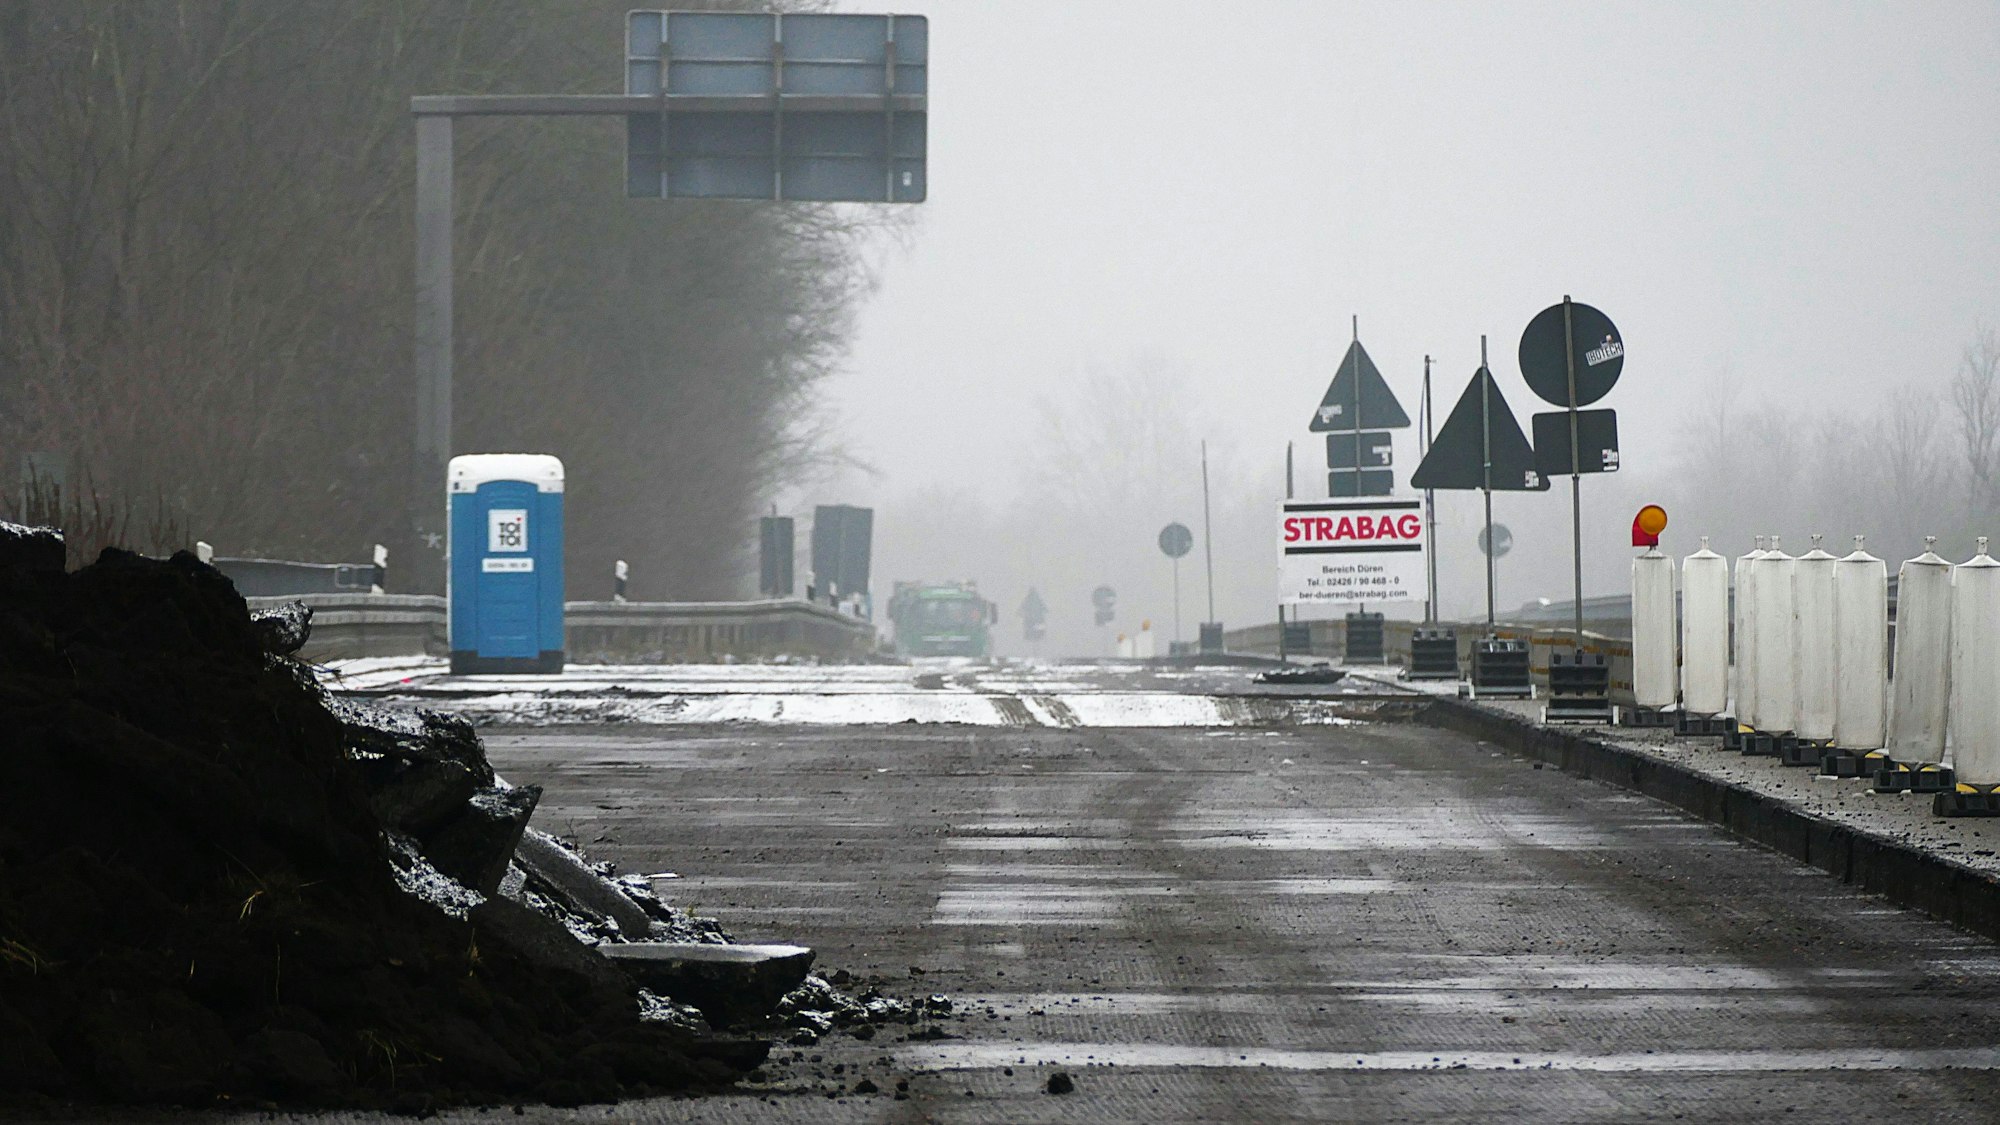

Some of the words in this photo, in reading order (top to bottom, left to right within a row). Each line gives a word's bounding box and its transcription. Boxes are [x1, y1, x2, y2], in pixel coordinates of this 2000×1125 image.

[1284, 514, 1421, 542] STRABAG
[498, 534, 521, 546] TOI
[1322, 565, 1355, 574] Bereich
[1357, 564, 1383, 573] Düren
[1327, 577, 1352, 586] 02426
[1359, 577, 1369, 585] 90
[1371, 576, 1386, 585] 468
[1394, 576, 1400, 584] 0
[1299, 590, 1407, 600] ber-dueren@strabag.com
